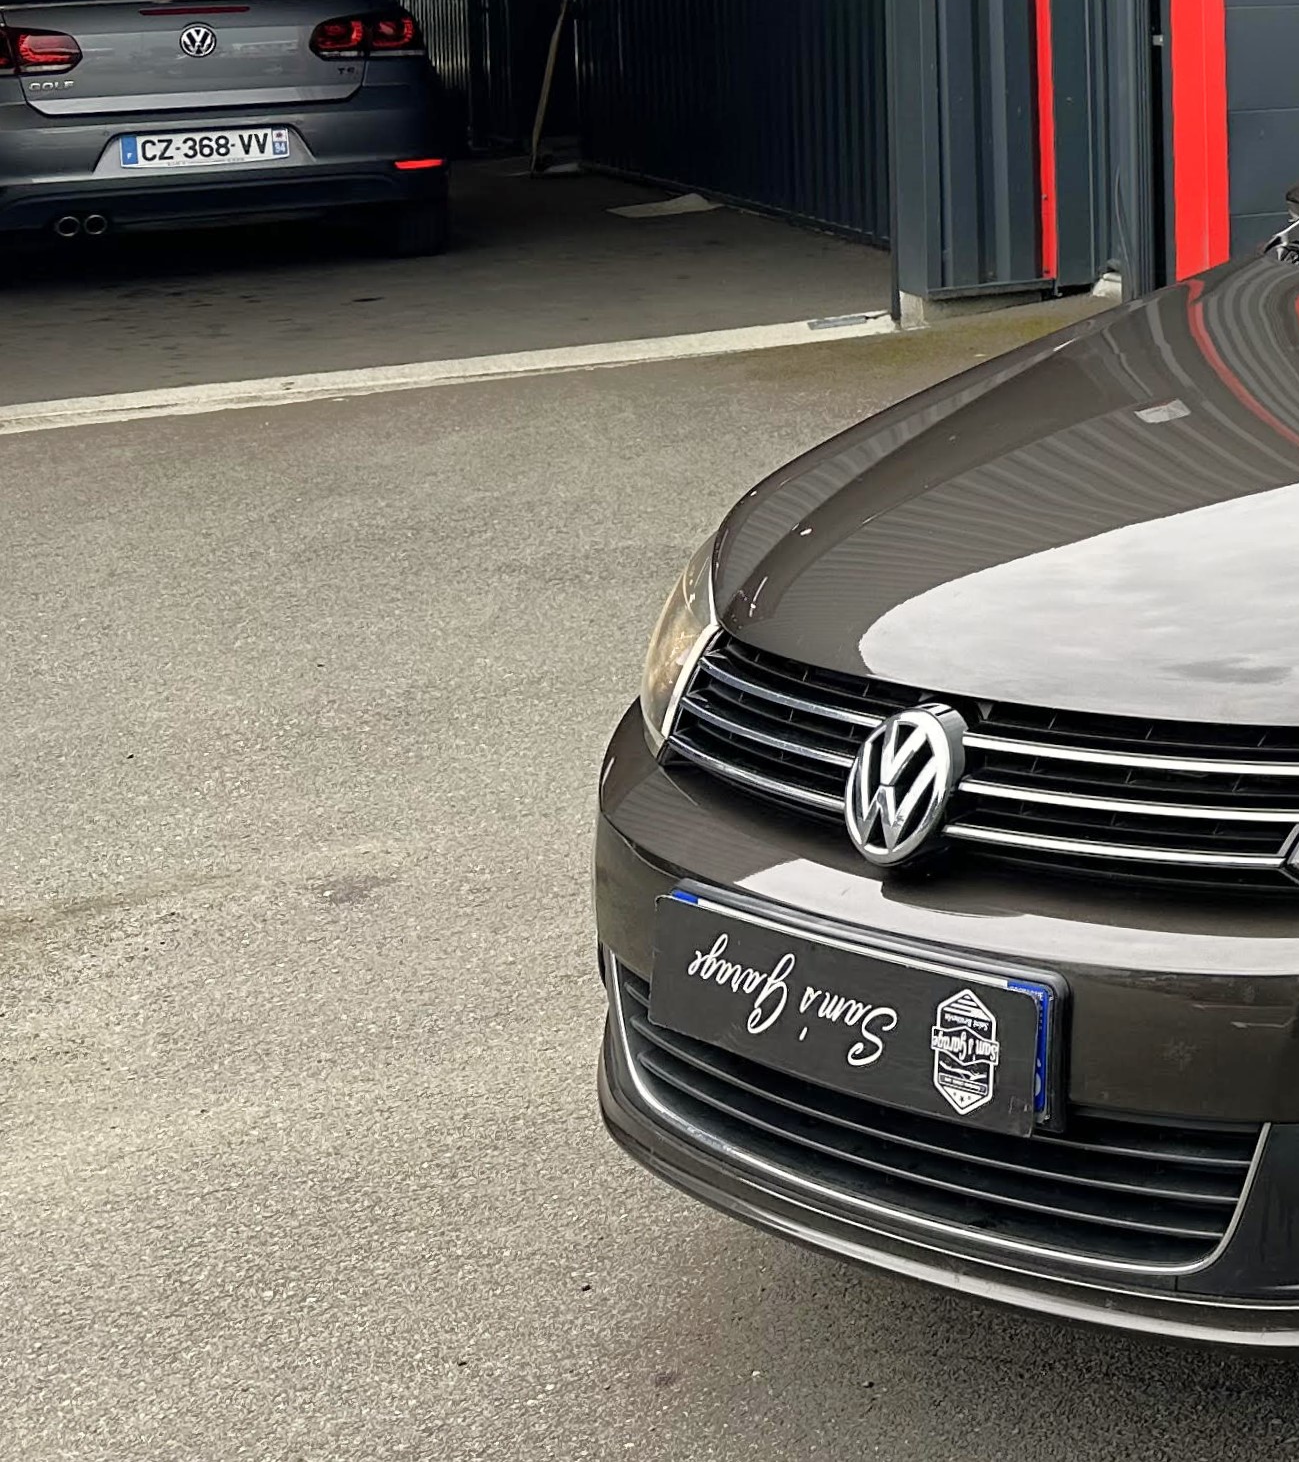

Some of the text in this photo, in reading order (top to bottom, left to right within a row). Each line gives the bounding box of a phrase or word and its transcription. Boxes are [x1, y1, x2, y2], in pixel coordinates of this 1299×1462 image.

[141, 132, 269, 162] CZ-368-VV
[687, 933, 899, 1067] Sam's Garage
